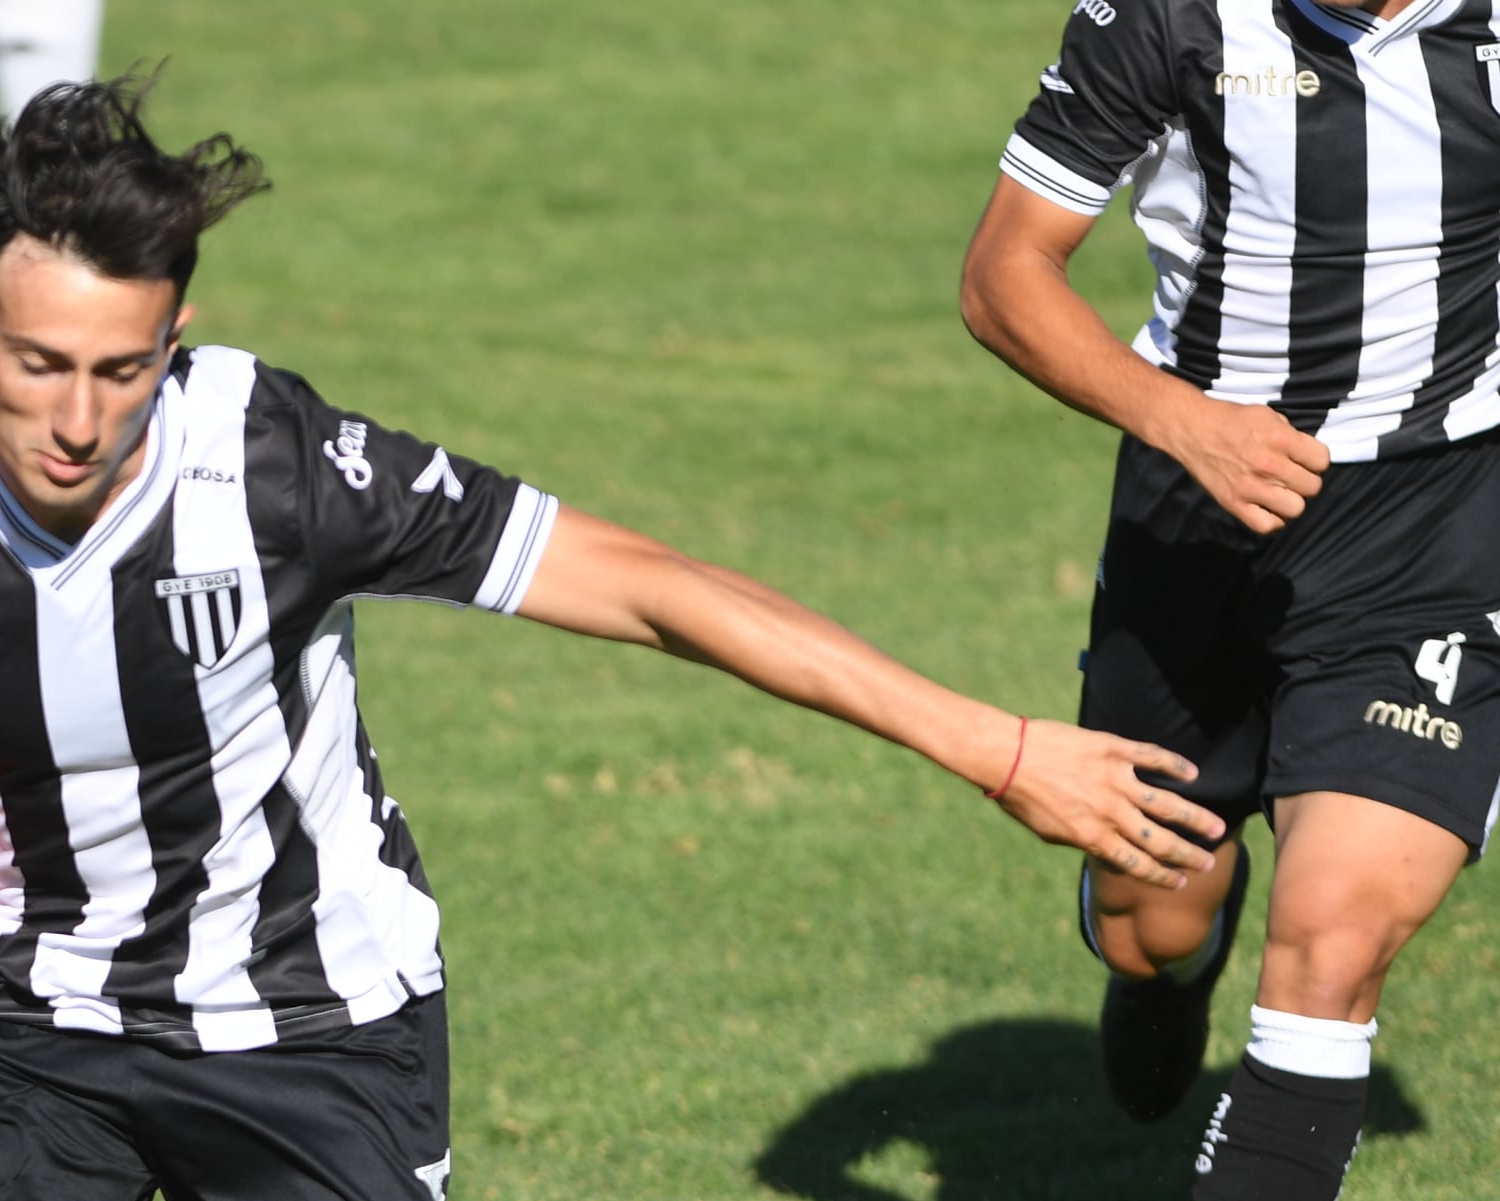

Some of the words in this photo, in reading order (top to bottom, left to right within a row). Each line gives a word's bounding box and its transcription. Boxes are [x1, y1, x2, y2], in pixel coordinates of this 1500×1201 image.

[1214, 65, 1321, 97] mitre
[199, 574, 232, 588] 1908
[1414, 631, 1467, 706] 4
[1364, 699, 1464, 750] mitre
